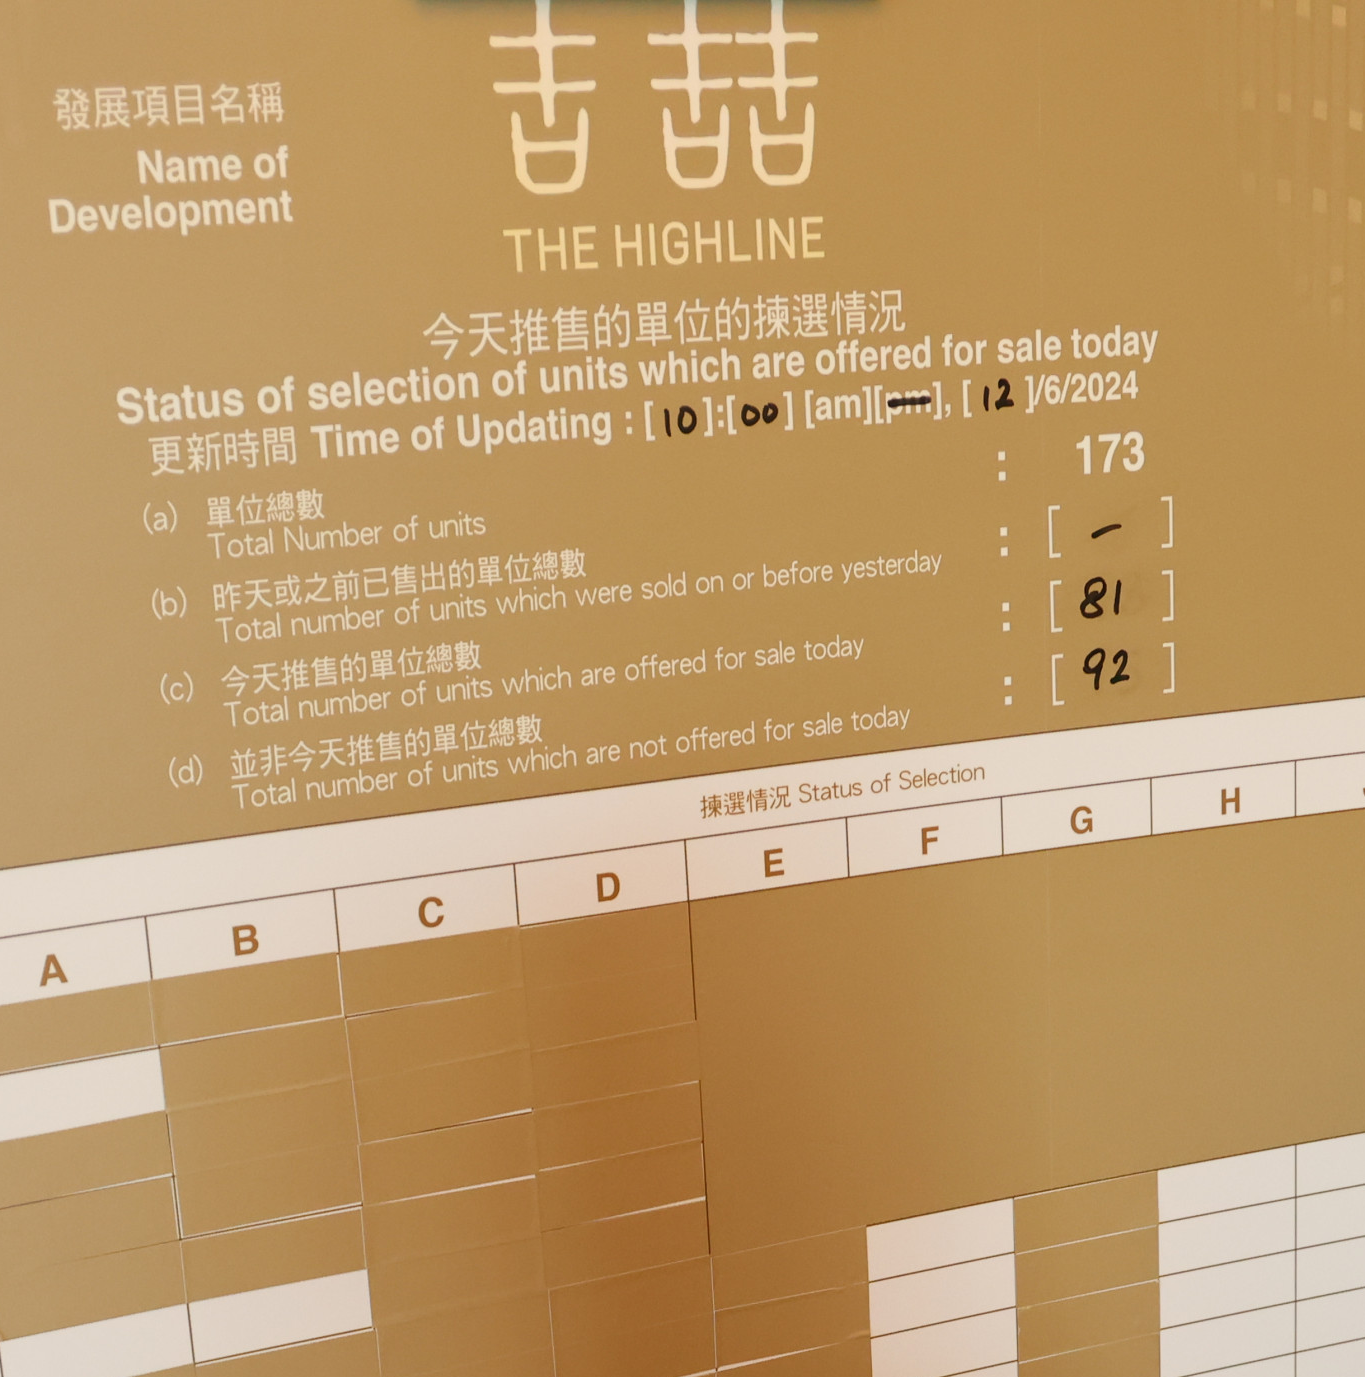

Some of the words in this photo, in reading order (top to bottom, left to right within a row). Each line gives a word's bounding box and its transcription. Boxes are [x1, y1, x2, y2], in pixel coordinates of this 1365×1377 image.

[53, 82, 285, 130] 發展項目名稱
[137, 150, 243, 184] Name
[253, 145, 289, 179] of
[48, 190, 293, 236] Development
[503, 225, 600, 272] THE
[614, 216, 826, 267] HIGHLINE
[423, 290, 906, 360] 今天推售的單位的揀選情況
[115, 384, 245, 425] Status
[256, 376, 296, 416] of
[306, 367, 480, 412] selection
[490, 361, 528, 400] of
[538, 357, 629, 396] units
[638, 348, 742, 390] which
[751, 352, 807, 382] are
[814, 336, 933, 378] offered
[941, 334, 988, 369] for
[995, 329, 1063, 365] sale
[1070, 324, 1160, 365] today
[148, 426, 299, 476] 更新時間
[309, 424, 401, 460] Time
[409, 416, 446, 452] of
[455, 407, 613, 455] Updating
[1076, 431, 1146, 475] 173
[143, 501, 178, 535] (a)
[207, 488, 325, 528] 單位總數
[207, 527, 275, 561] Total
[283, 520, 384, 554] Number
[392, 514, 419, 543] of
[428, 510, 487, 540] units
[152, 586, 187, 621] (b)
[212, 547, 587, 613] 昨天或之前已售出的單位總數
[214, 610, 282, 645] Total
[290, 603, 385, 637] number
[393, 597, 420, 627] of
[429, 592, 488, 623] units
[495, 582, 567, 616] which
[575, 584, 633, 608] were
[640, 571, 687, 602] sold
[695, 575, 724, 596] on
[732, 572, 755, 593] or
[762, 560, 834, 590] before
[840, 548, 944, 586] yesterday
[160, 671, 194, 705] (c)
[221, 640, 482, 697] 今天推售的單位總數
[223, 694, 290, 729] Total
[297, 685, 392, 721] number
[400, 678, 427, 709] of
[435, 673, 494, 705] units
[500, 662, 572, 697] which
[580, 665, 616, 688] are
[624, 647, 707, 683] offered
[714, 645, 747, 672] for
[753, 638, 796, 668] sale
[803, 632, 866, 662] today
[1082, 648, 1131, 691] 92
[169, 754, 203, 789] (d)
[230, 713, 543, 781] 並非今天推售的單位總數
[231, 775, 298, 811] Total
[305, 766, 399, 802] number
[406, 758, 434, 789] of
[442, 753, 499, 785] units
[506, 741, 578, 777] which
[585, 744, 621, 767] are
[629, 731, 668, 761] not
[675, 719, 756, 755] offered
[763, 717, 796, 744] for
[802, 710, 844, 739] sale
[850, 703, 912, 733] today
[701, 785, 792, 819] 揀選情況
[798, 779, 864, 805] Status
[869, 771, 892, 796] of
[897, 762, 987, 792] Selection
[1221, 787, 1240, 815] H
[921, 826, 939, 855] F
[1070, 806, 1093, 834] G
[764, 848, 784, 877] E
[596, 872, 620, 902] D
[418, 897, 444, 928] C
[232, 924, 259, 956] B
[40, 954, 68, 986] A
